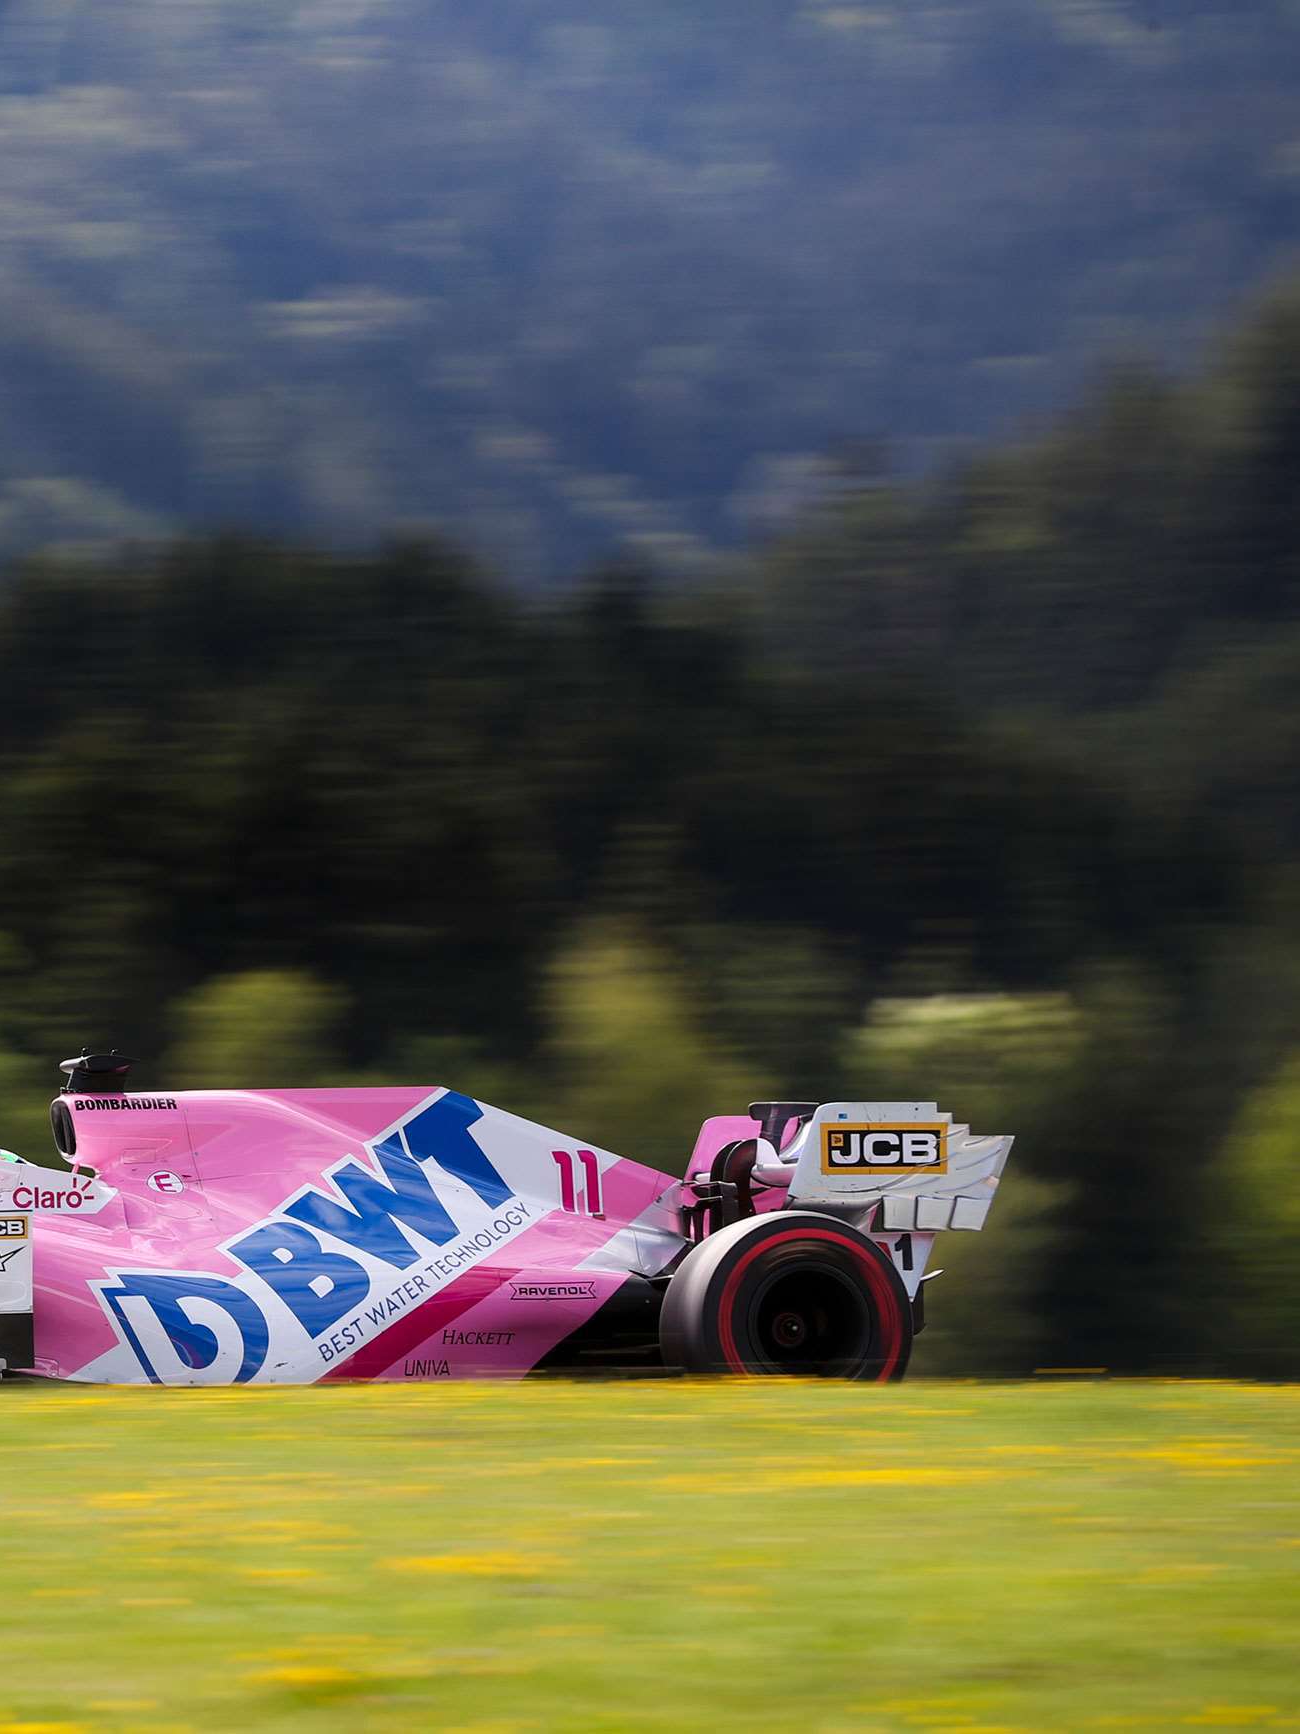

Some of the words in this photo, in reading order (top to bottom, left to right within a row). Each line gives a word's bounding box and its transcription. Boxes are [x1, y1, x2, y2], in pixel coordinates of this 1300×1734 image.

[74, 1098, 178, 1111] BOMBARDIER
[830, 1133, 938, 1164] JCB
[550, 1149, 602, 1214] 11
[12, 1186, 83, 1209] Claro
[227, 1090, 516, 1340] BWT
[318, 1318, 364, 1362] BEST
[364, 1275, 430, 1326] WATER
[425, 1202, 531, 1281] TECHNOLOGY
[518, 1286, 587, 1296] RAVENOL
[442, 1329, 516, 1345] HACKETT
[404, 1360, 451, 1377] UNIVA
